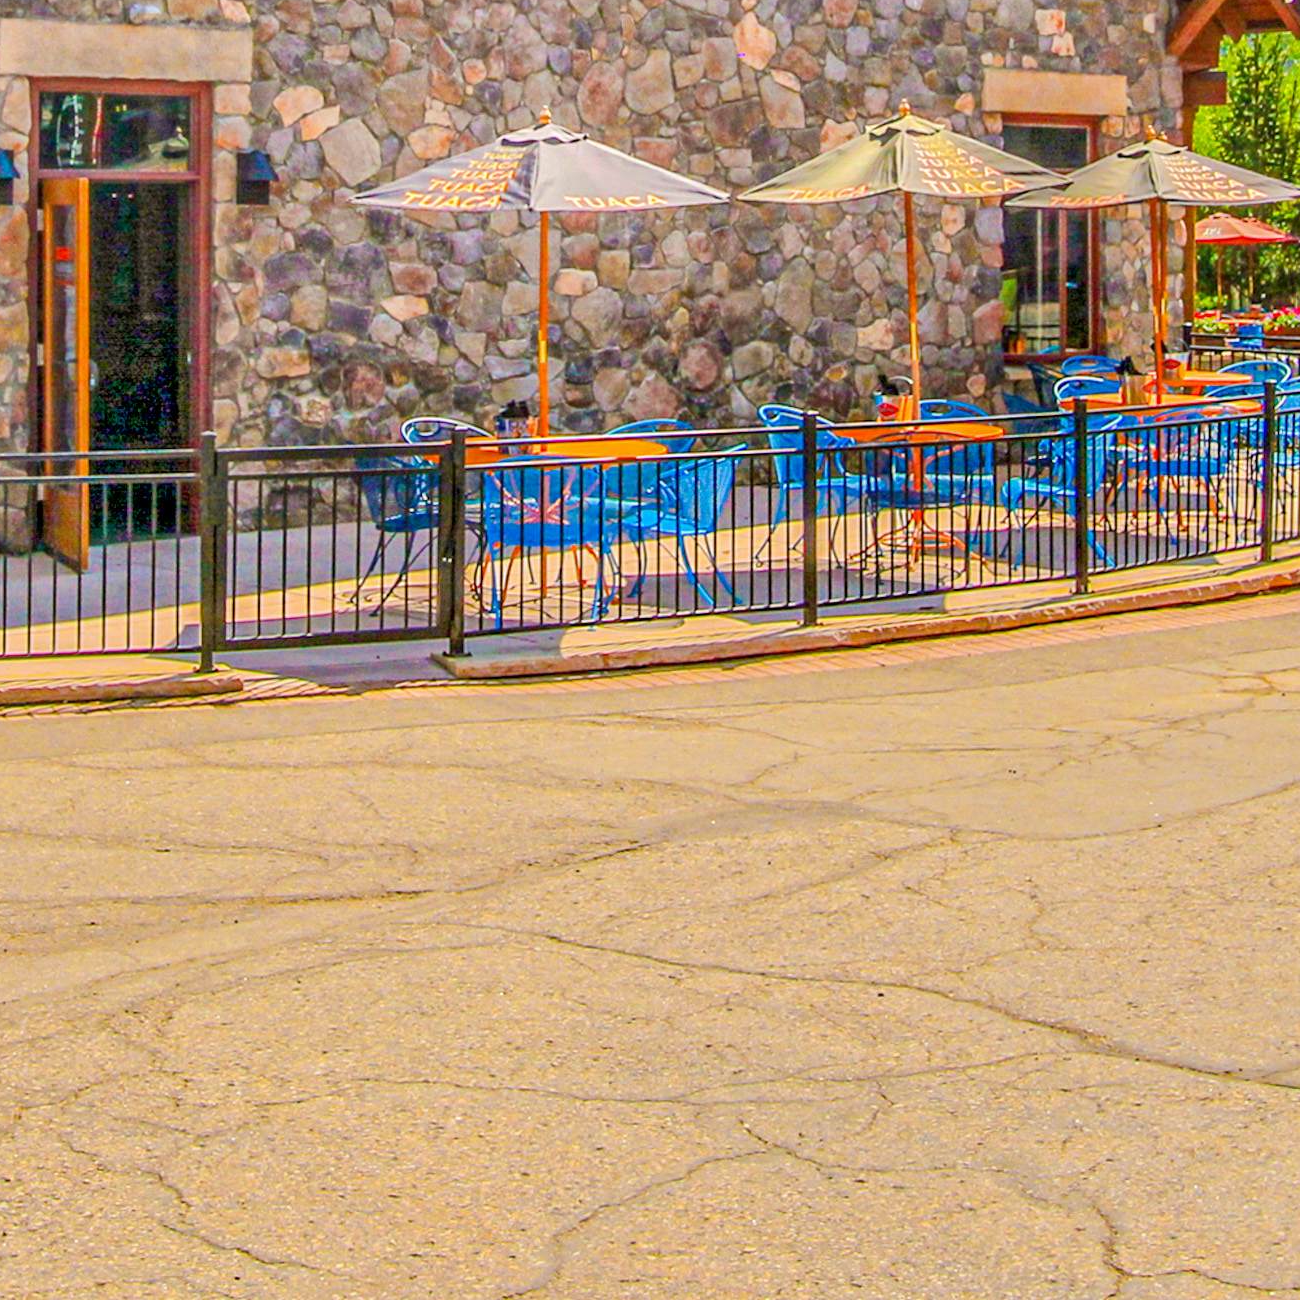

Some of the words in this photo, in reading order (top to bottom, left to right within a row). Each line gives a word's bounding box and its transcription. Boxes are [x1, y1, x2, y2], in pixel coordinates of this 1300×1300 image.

[469, 159, 520, 169] TUACA
[918, 157, 983, 168] TUACA
[451, 168, 516, 180] TUACA
[919, 166, 1001, 180] TUACA
[1168, 171, 1228, 181] TUACA
[428, 178, 508, 194] TUACA
[789, 183, 870, 200] TUACA
[922, 177, 1026, 195] TUACA
[1172, 179, 1245, 191] TUACA
[402, 191, 503, 211] TUACA
[563, 192, 669, 208] TUACA
[1177, 187, 1269, 201] TUACA
